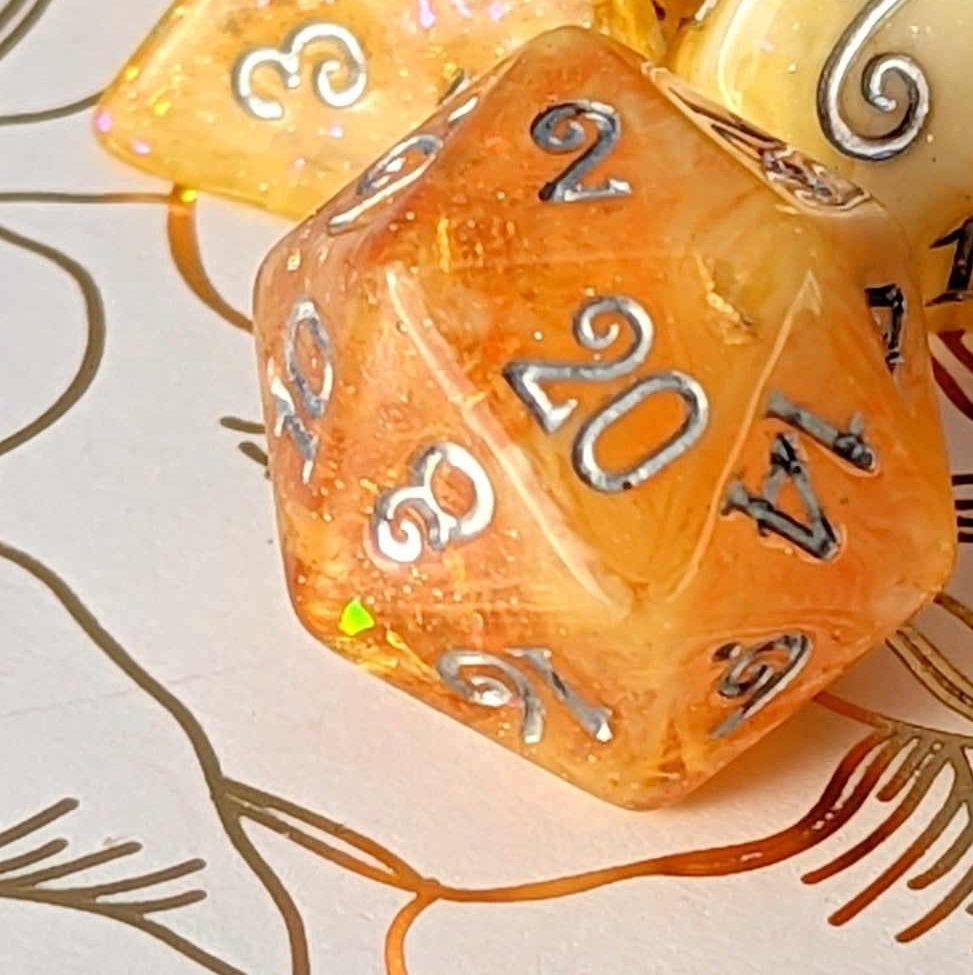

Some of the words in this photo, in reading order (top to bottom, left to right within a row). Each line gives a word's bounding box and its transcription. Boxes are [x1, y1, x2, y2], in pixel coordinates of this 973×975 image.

[233, 20, 369, 121] 3
[530, 99, 634, 203] 2
[505, 294, 710, 495] 20
[370, 440, 498, 565] 8
[721, 387, 880, 563] 14
